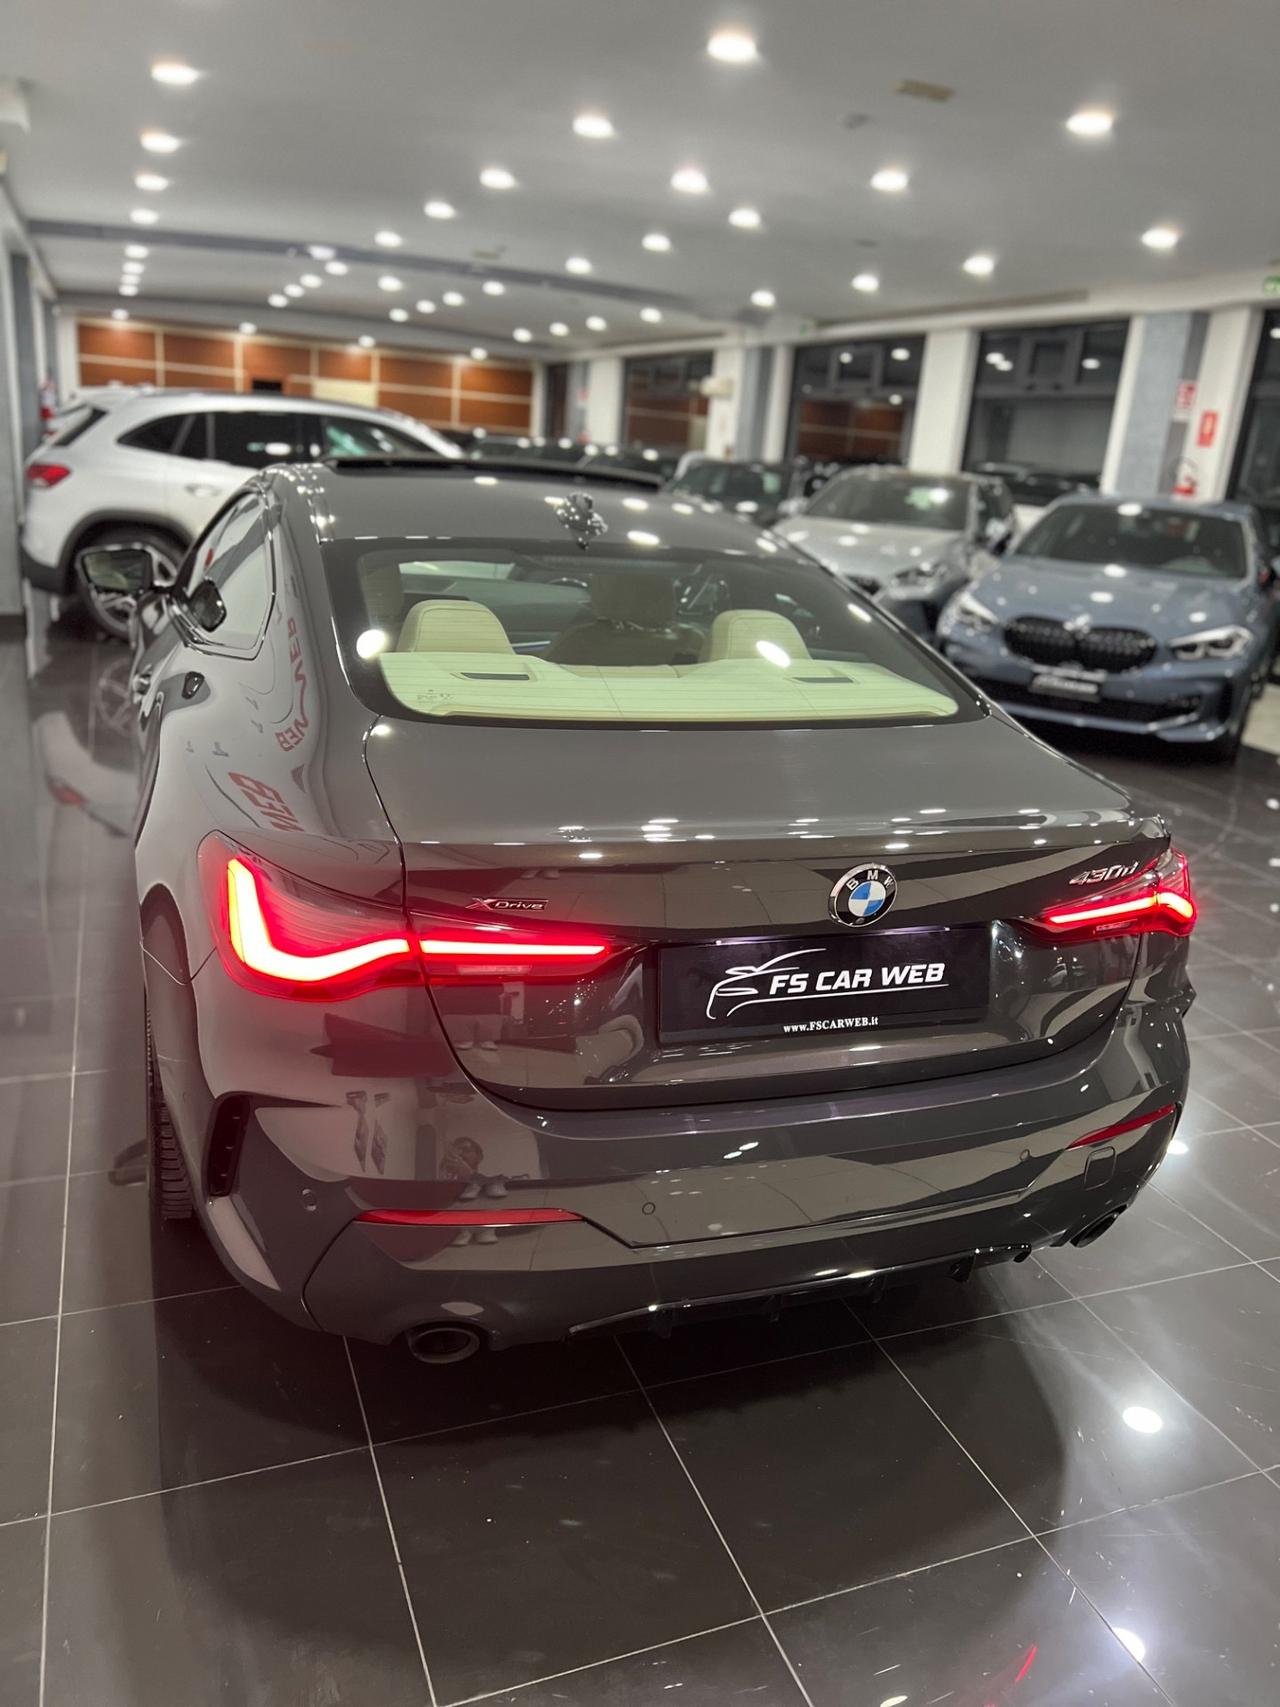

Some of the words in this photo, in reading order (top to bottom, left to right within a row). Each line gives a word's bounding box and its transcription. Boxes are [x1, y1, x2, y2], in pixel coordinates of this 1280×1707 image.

[846, 870, 894, 890] BMW
[769, 973, 809, 995] FS
[815, 968, 873, 991] CAR
[881, 963, 945, 986] WEB
[783, 1016, 879, 1033] www.FSCARWEB.it
